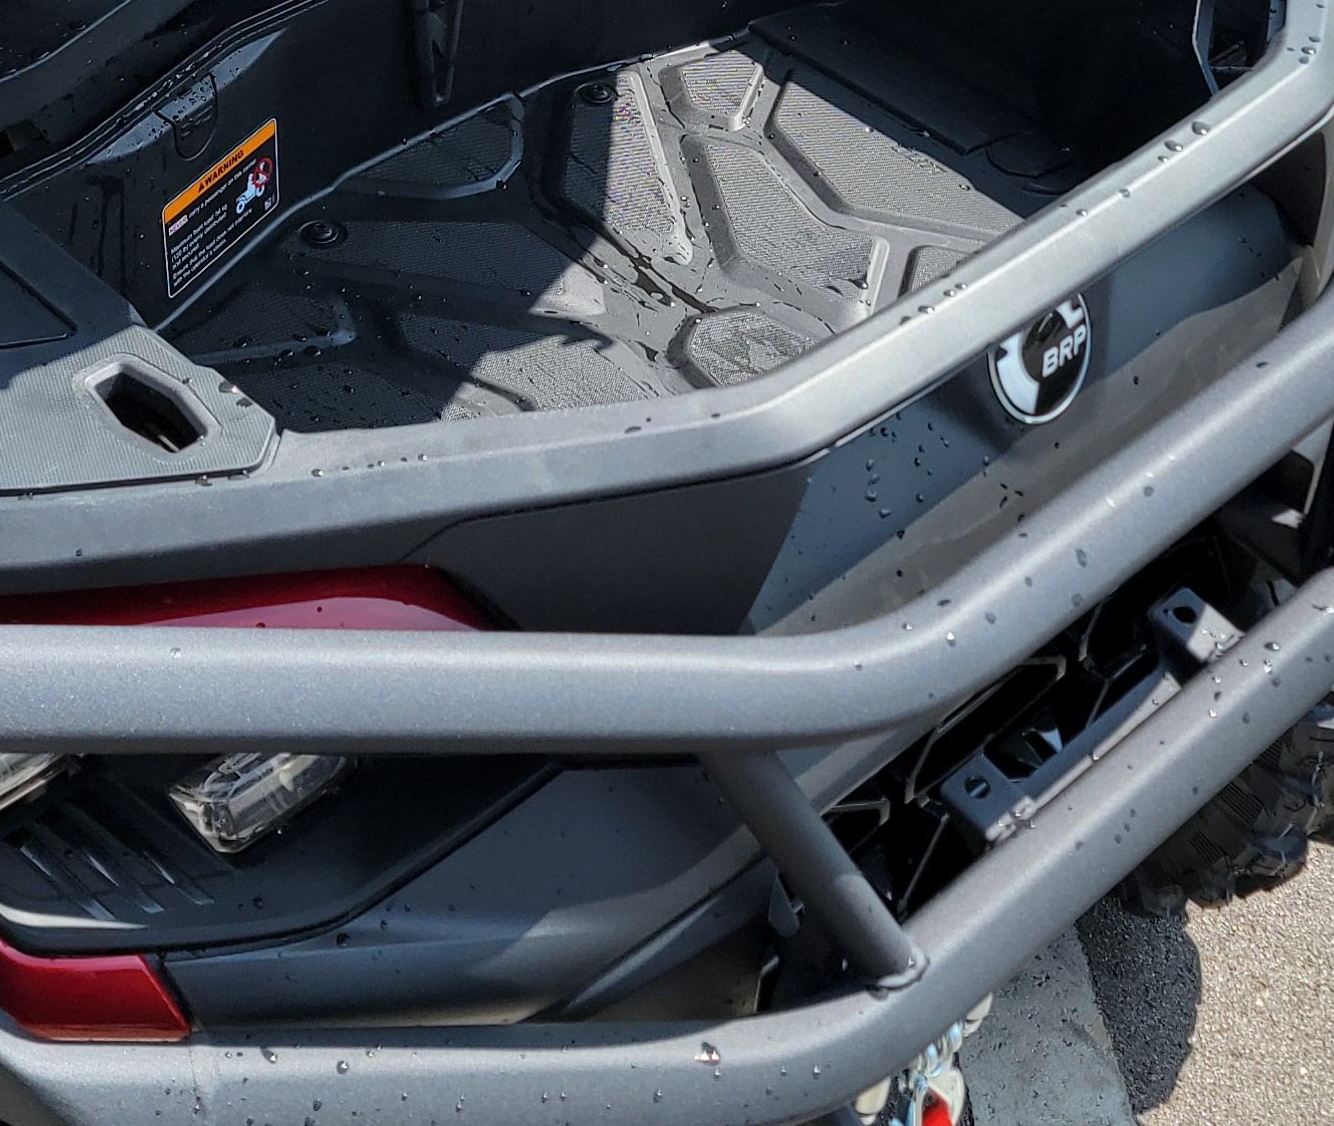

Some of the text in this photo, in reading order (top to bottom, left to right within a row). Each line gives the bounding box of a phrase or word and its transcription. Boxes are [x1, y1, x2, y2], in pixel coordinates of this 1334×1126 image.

[205, 148, 243, 186] WARNING
[188, 204, 199, 220] carry
[204, 181, 227, 207] passenger
[170, 231, 192, 255] Maximum
[1042, 324, 1086, 378] BRP
